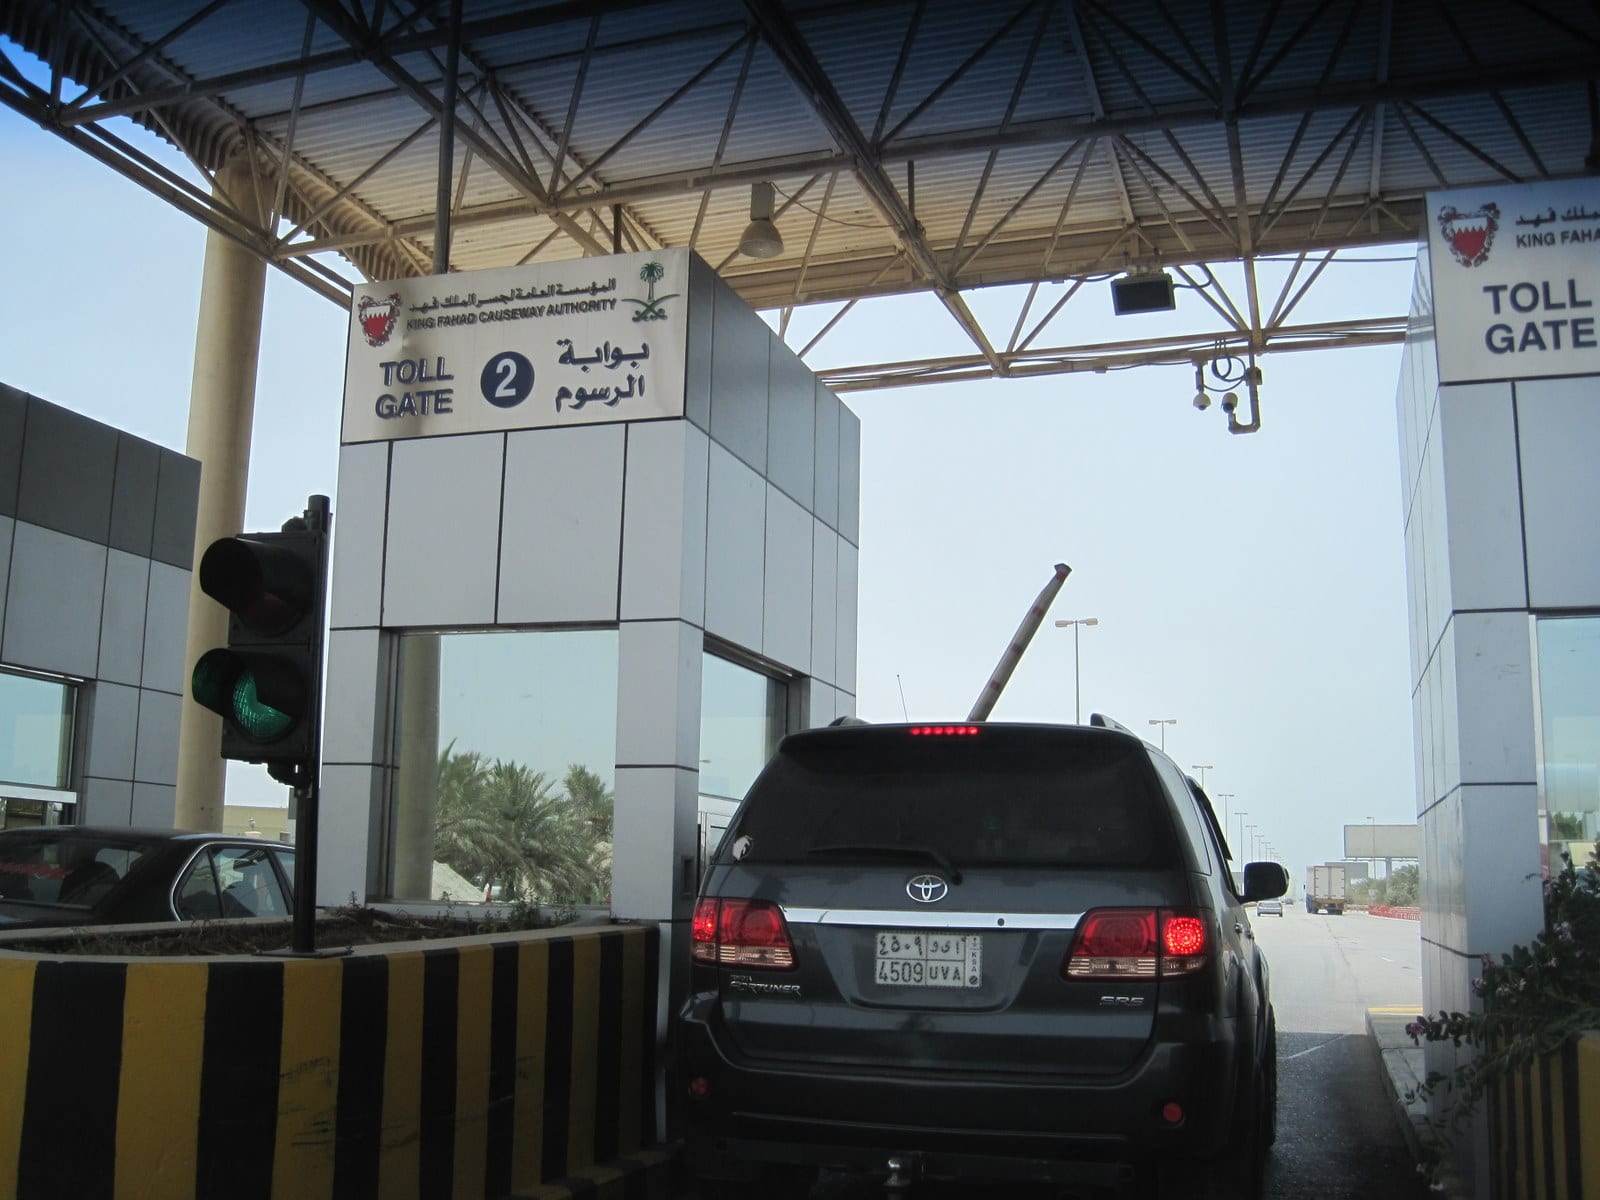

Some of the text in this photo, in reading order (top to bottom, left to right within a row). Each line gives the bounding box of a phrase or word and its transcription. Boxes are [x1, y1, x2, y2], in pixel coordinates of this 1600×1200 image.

[1515, 206, 1556, 228] فهد
[1516, 231, 1556, 249] KING
[440, 292, 477, 309] الملك
[516, 284, 556, 300] العامة
[556, 278, 617, 296] المؤسسة
[1482, 278, 1593, 315] TOLL
[406, 298, 617, 331] KING FAHAD CAUSEWAY AUTHORITY
[408, 295, 440, 314] فهد
[1484, 317, 1598, 354] GATE
[556, 338, 650, 373] بوابة
[379, 356, 455, 387] TOLL
[494, 358, 518, 399] 2
[375, 388, 455, 419] GATE
[555, 373, 646, 413] الرسوم
[878, 961, 961, 983] 4509 UVA
